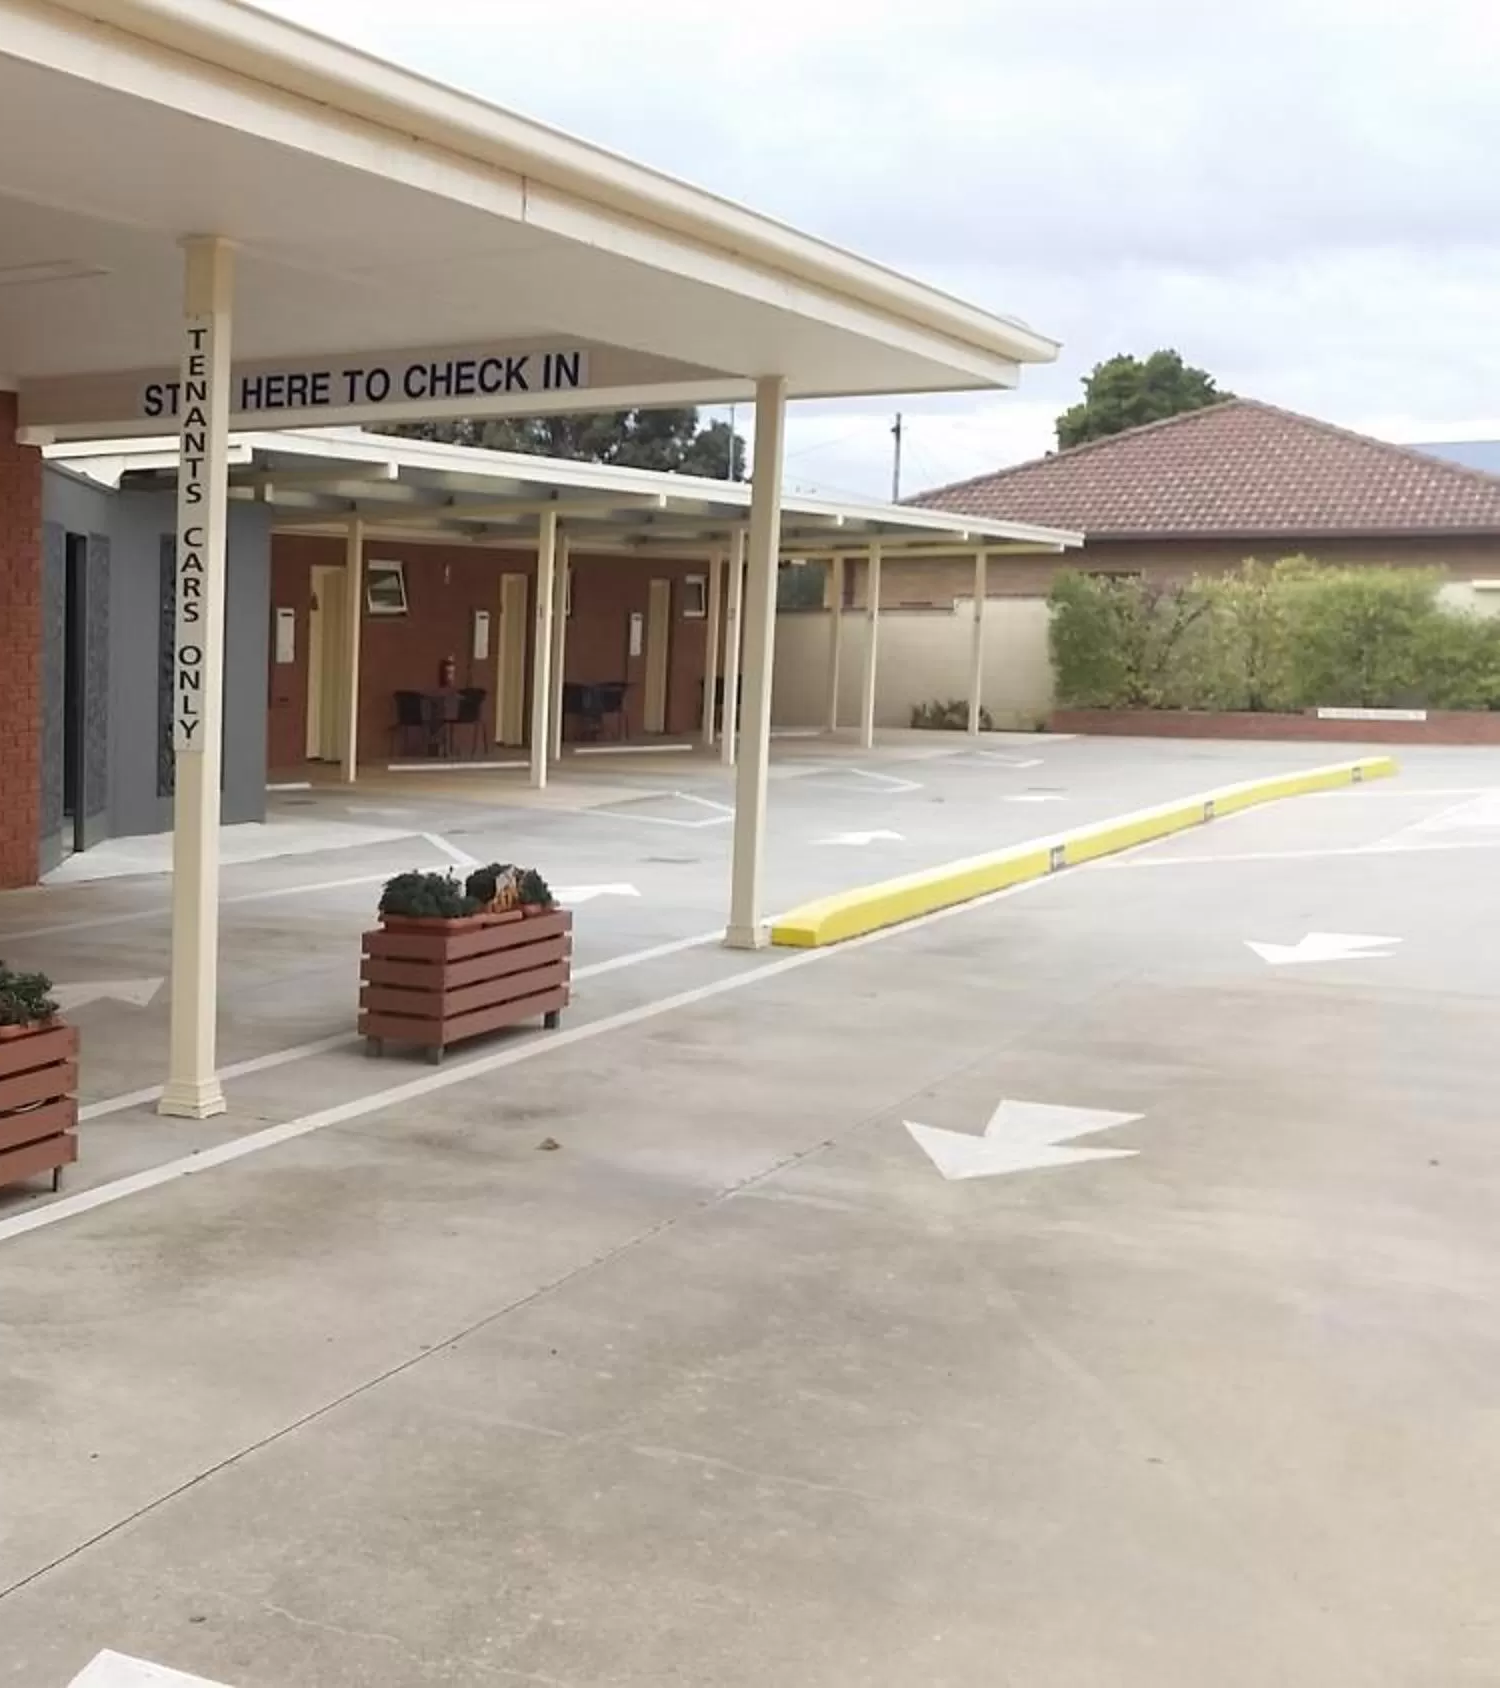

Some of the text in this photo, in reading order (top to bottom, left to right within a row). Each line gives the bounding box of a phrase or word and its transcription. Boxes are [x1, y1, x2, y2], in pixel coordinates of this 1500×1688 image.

[144, 352, 581, 417] ST HERE TO CHECK IN
[178, 328, 208, 739] TENANTS CARS ONLY
